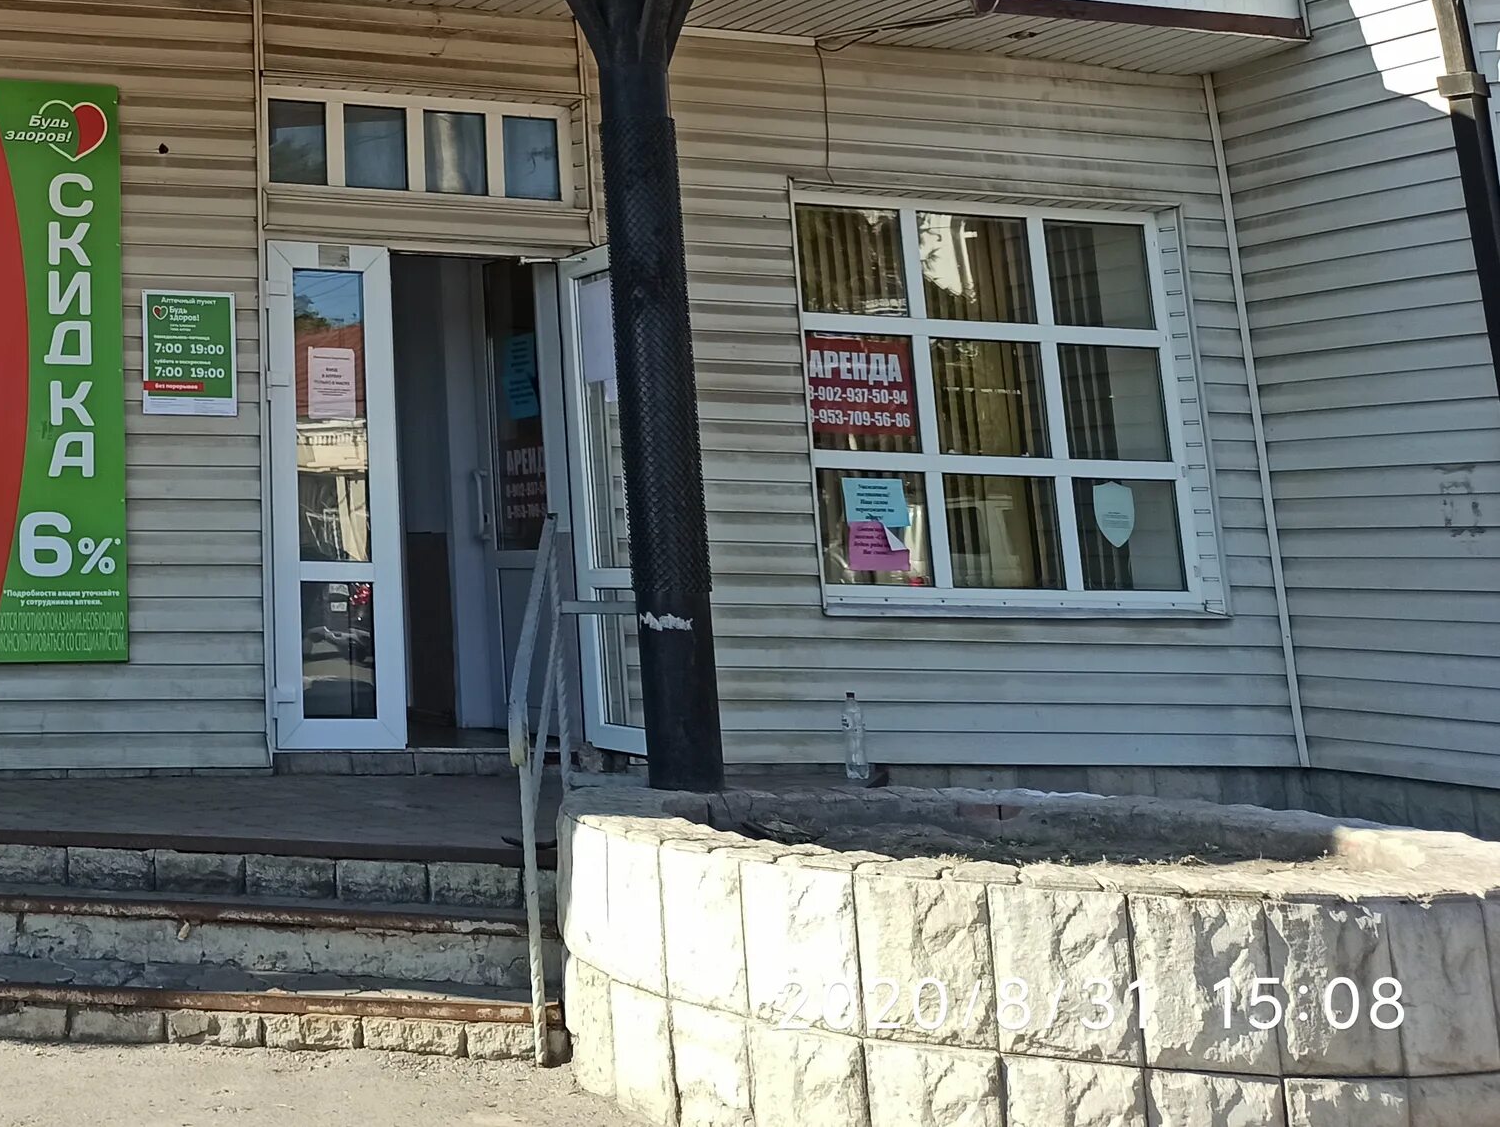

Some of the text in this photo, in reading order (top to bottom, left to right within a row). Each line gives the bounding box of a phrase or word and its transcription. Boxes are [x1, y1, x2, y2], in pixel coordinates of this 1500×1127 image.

[29, 114, 69, 130] Будь
[4, 130, 73, 143] здоров!
[169, 306, 188, 315] Будь
[43, 172, 95, 478] СКИДКА
[169, 314, 200, 323] здоров!
[153, 342, 225, 355] 7:00 19:00
[154, 366, 225, 378] 7:00 19:00
[809, 349, 903, 386] АРЕНДА
[808, 385, 908, 405] 8-902-937-50-94
[810, 408, 911, 427] 8-953-709-56-86
